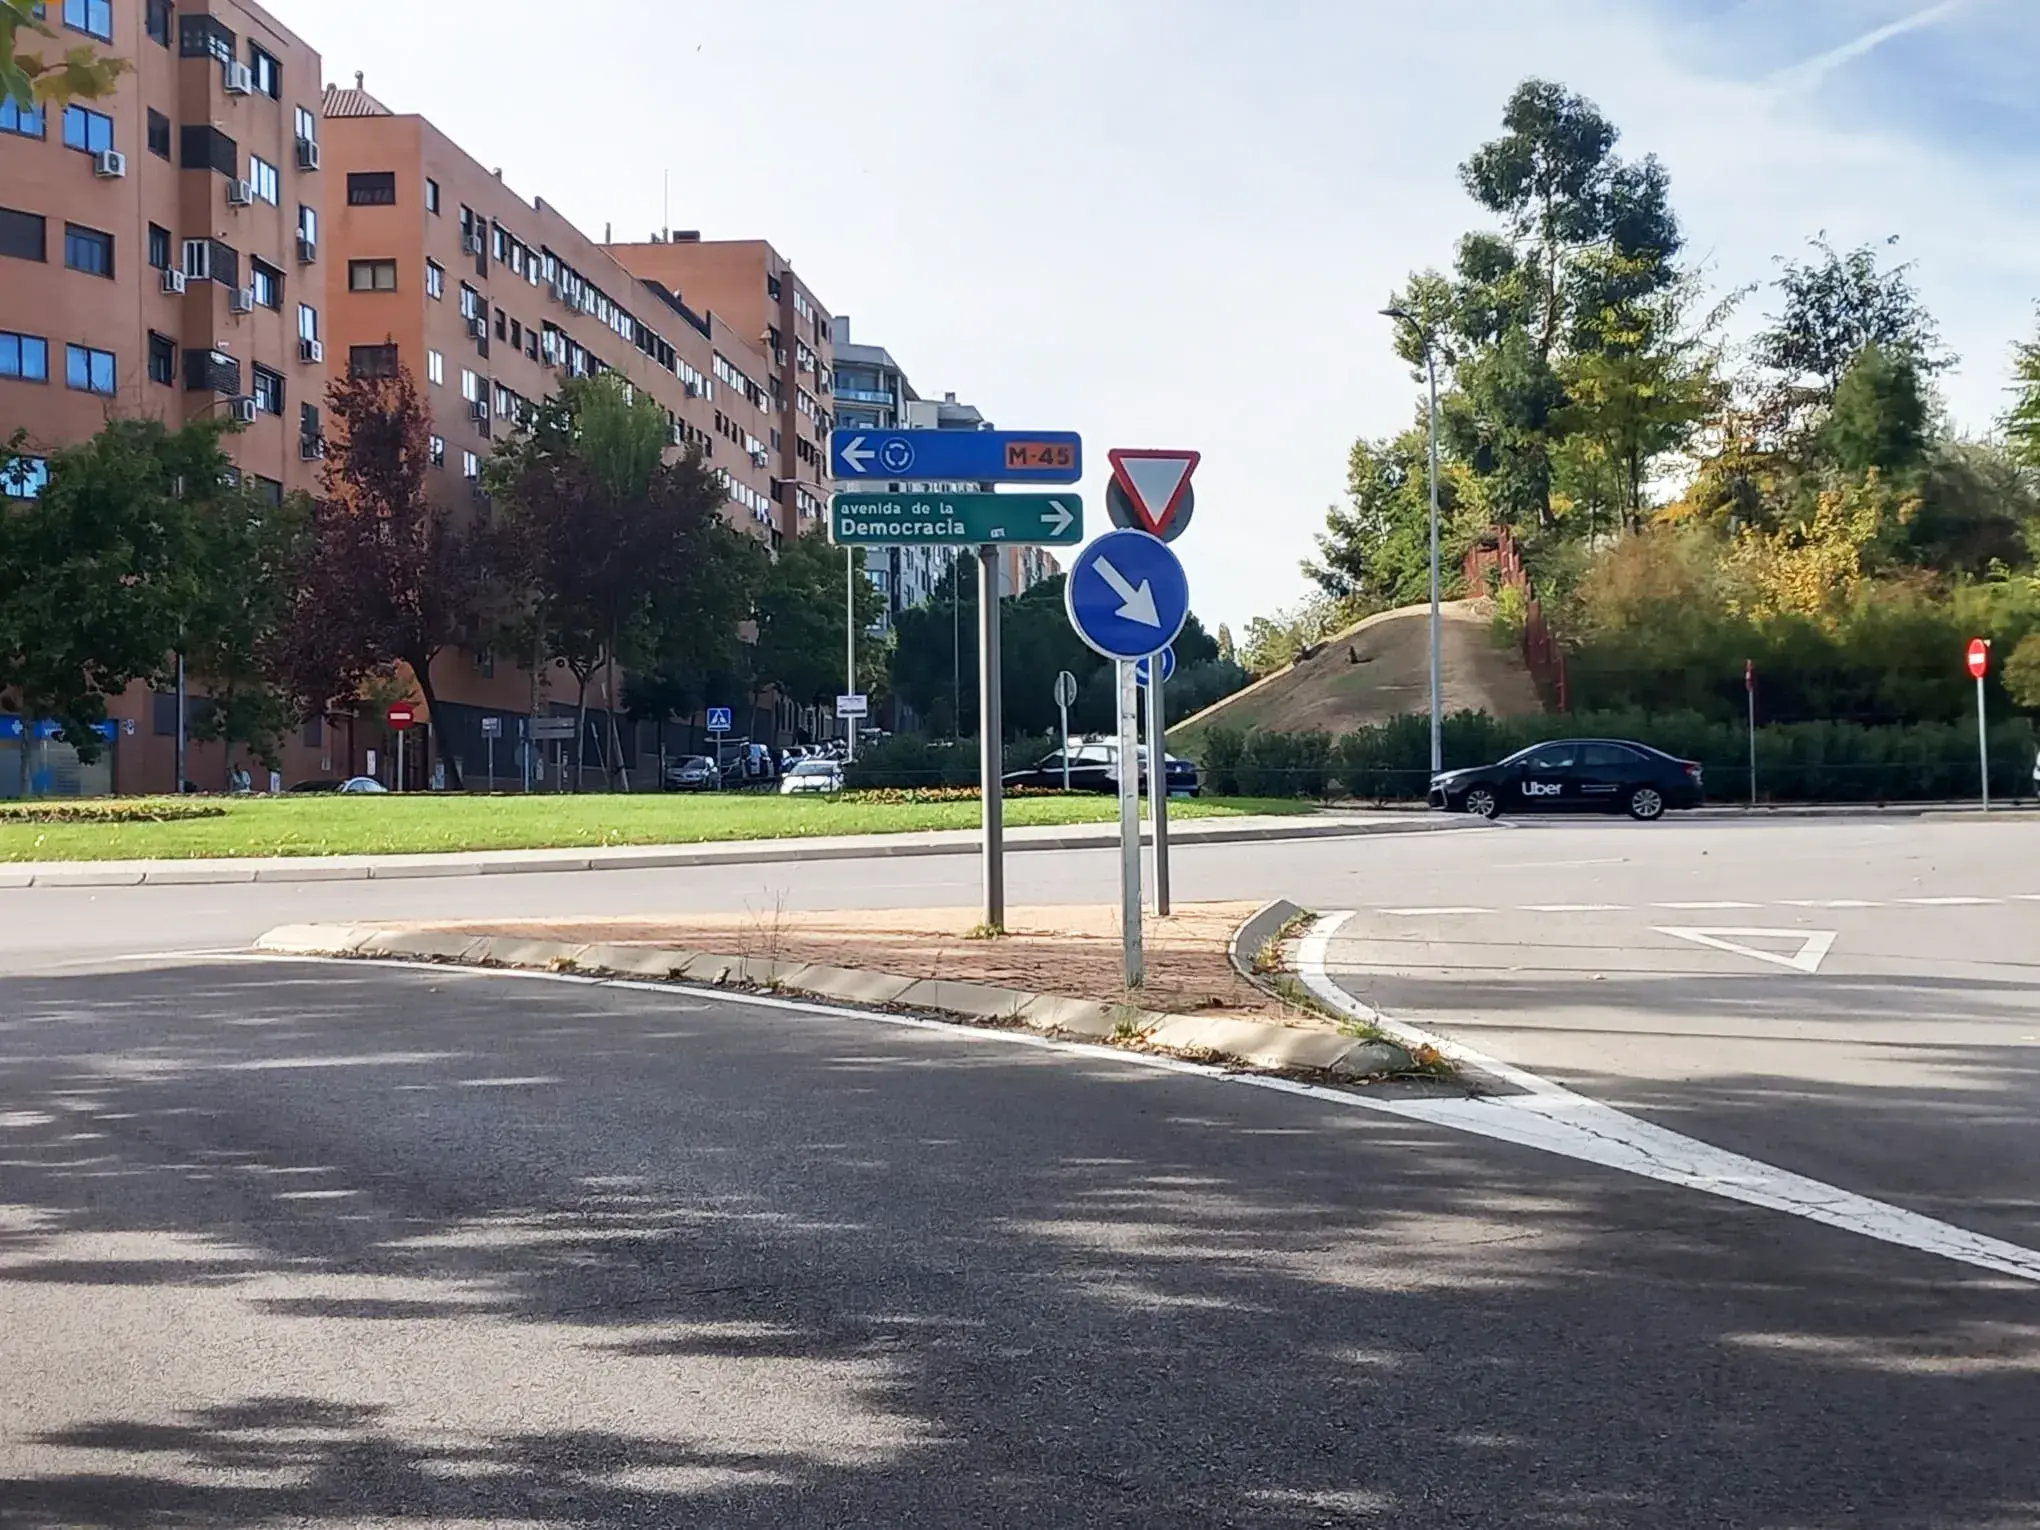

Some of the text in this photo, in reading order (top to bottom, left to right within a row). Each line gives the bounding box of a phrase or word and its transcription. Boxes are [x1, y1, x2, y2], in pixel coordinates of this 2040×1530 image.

[1008, 447, 1070, 465] M-45
[841, 502, 954, 514] avenida de la
[841, 518, 965, 535] Democracia
[1521, 781, 1562, 796] Uber
